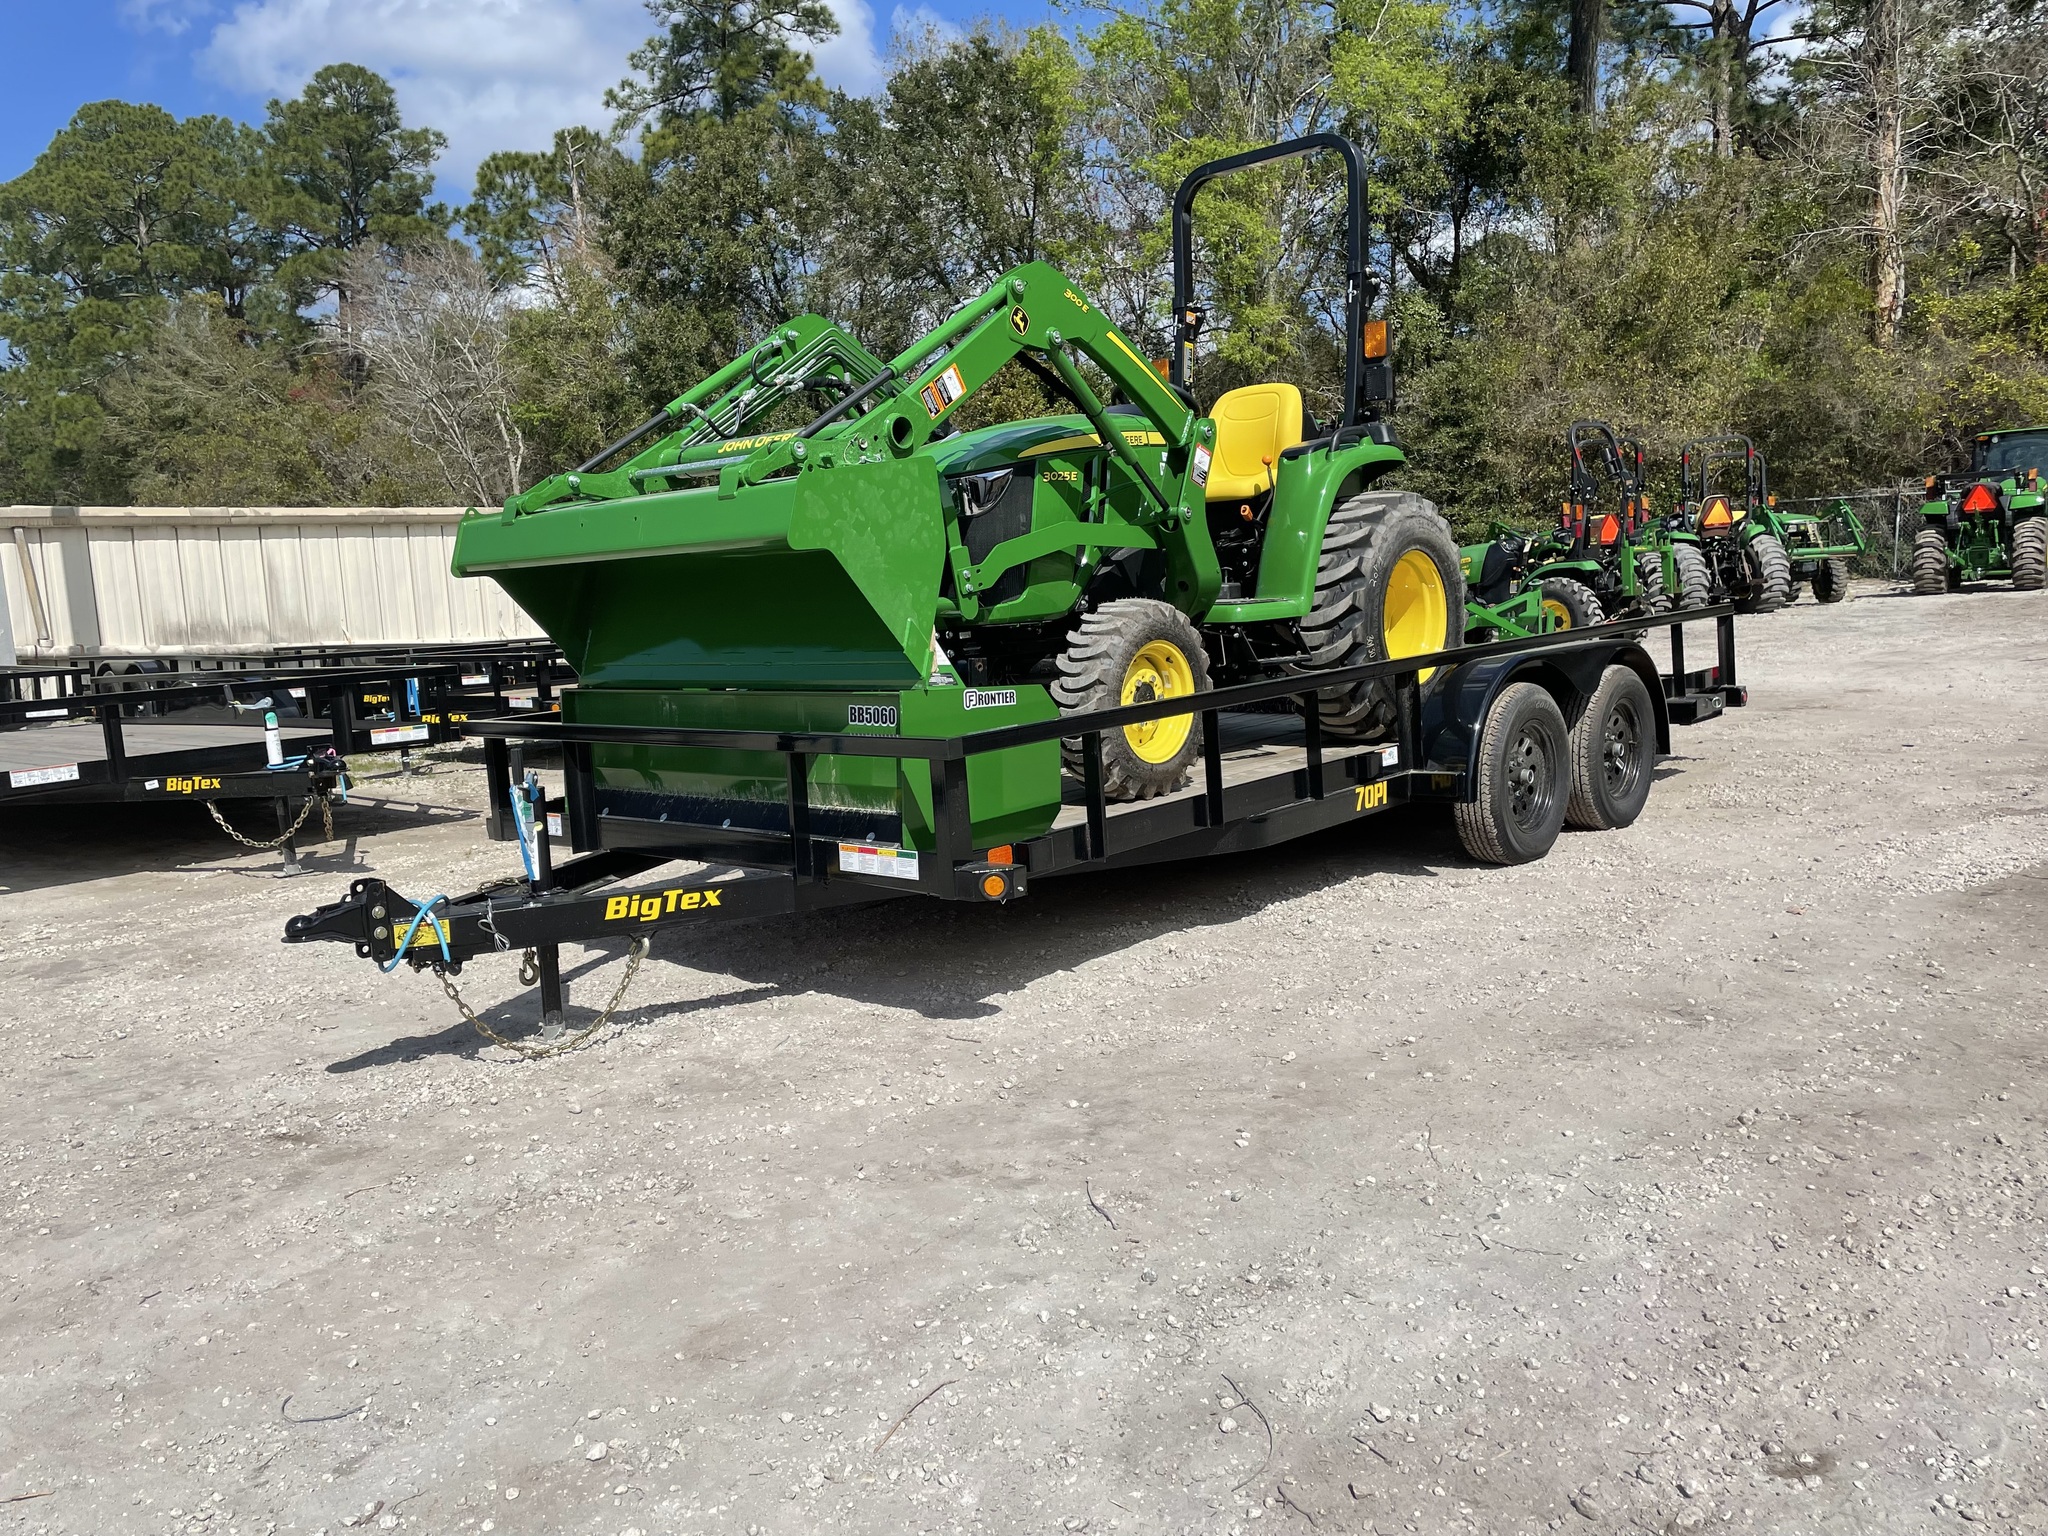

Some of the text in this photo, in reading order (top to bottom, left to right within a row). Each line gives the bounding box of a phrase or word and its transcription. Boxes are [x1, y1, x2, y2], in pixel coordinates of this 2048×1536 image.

[717, 438, 755, 454] JOHN
[1043, 471, 1078, 482] 3025E
[964, 690, 1016, 709] FRONTIER
[849, 706, 896, 725] BB5060
[166, 776, 221, 794] BigTex
[1355, 780, 1388, 812] 70PI
[604, 888, 723, 922] BigTex
